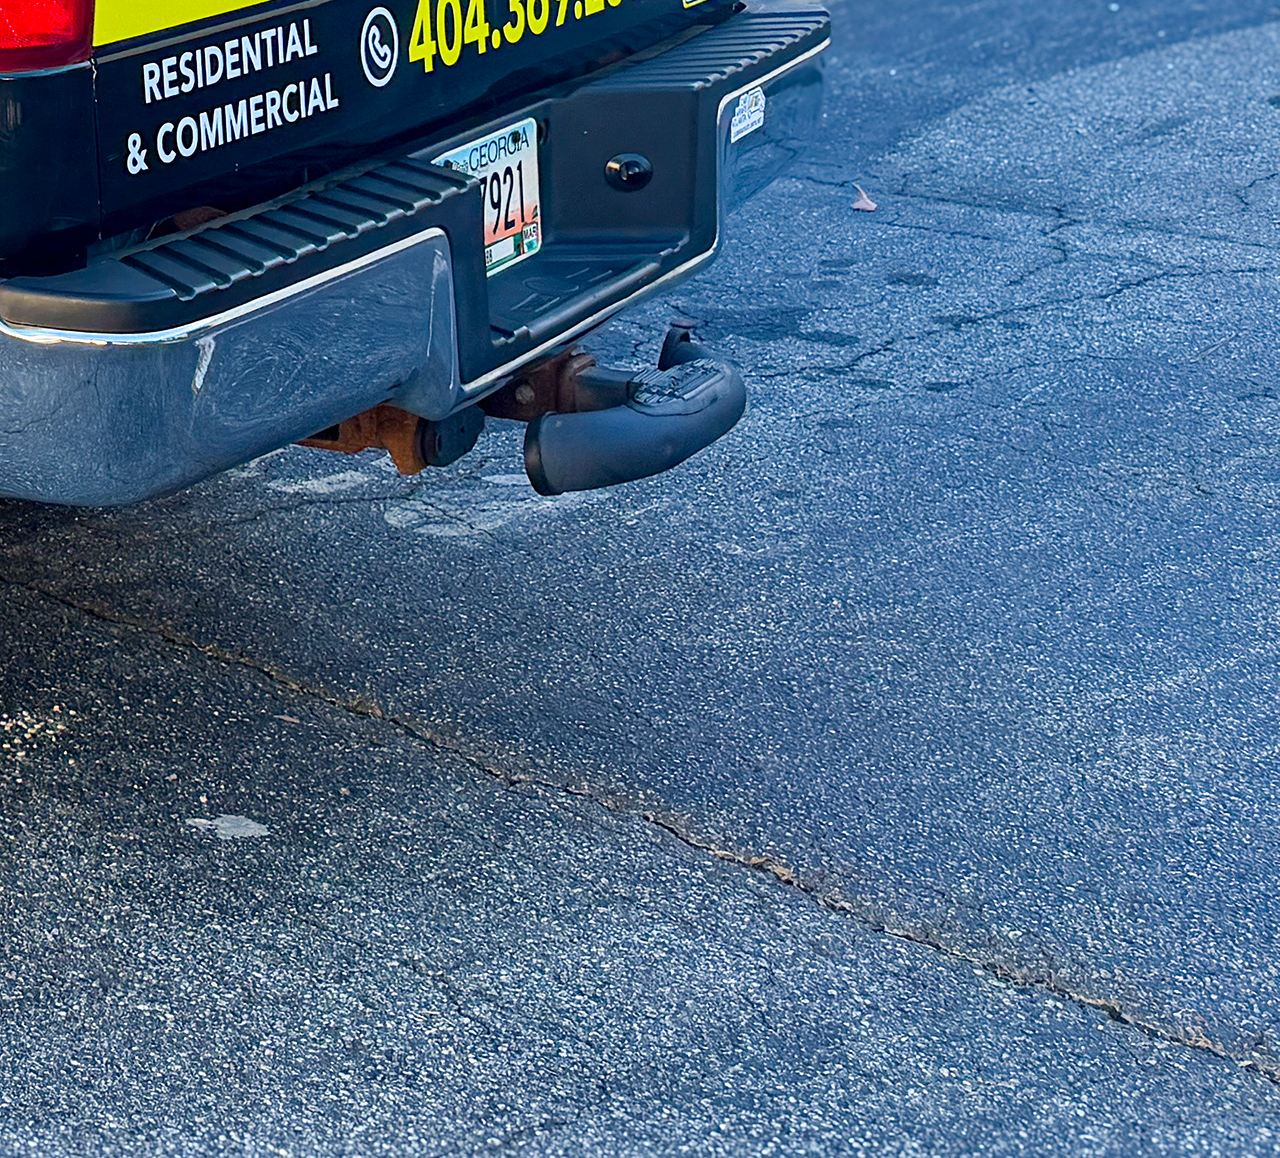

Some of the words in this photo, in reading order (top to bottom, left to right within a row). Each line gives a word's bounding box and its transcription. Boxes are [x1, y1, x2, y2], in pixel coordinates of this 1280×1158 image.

[143, 18, 318, 104] RESIDENTIAL
[126, 131, 148, 174] &
[156, 72, 339, 165] COMMERCIAL
[469, 127, 530, 172] GEORGIA
